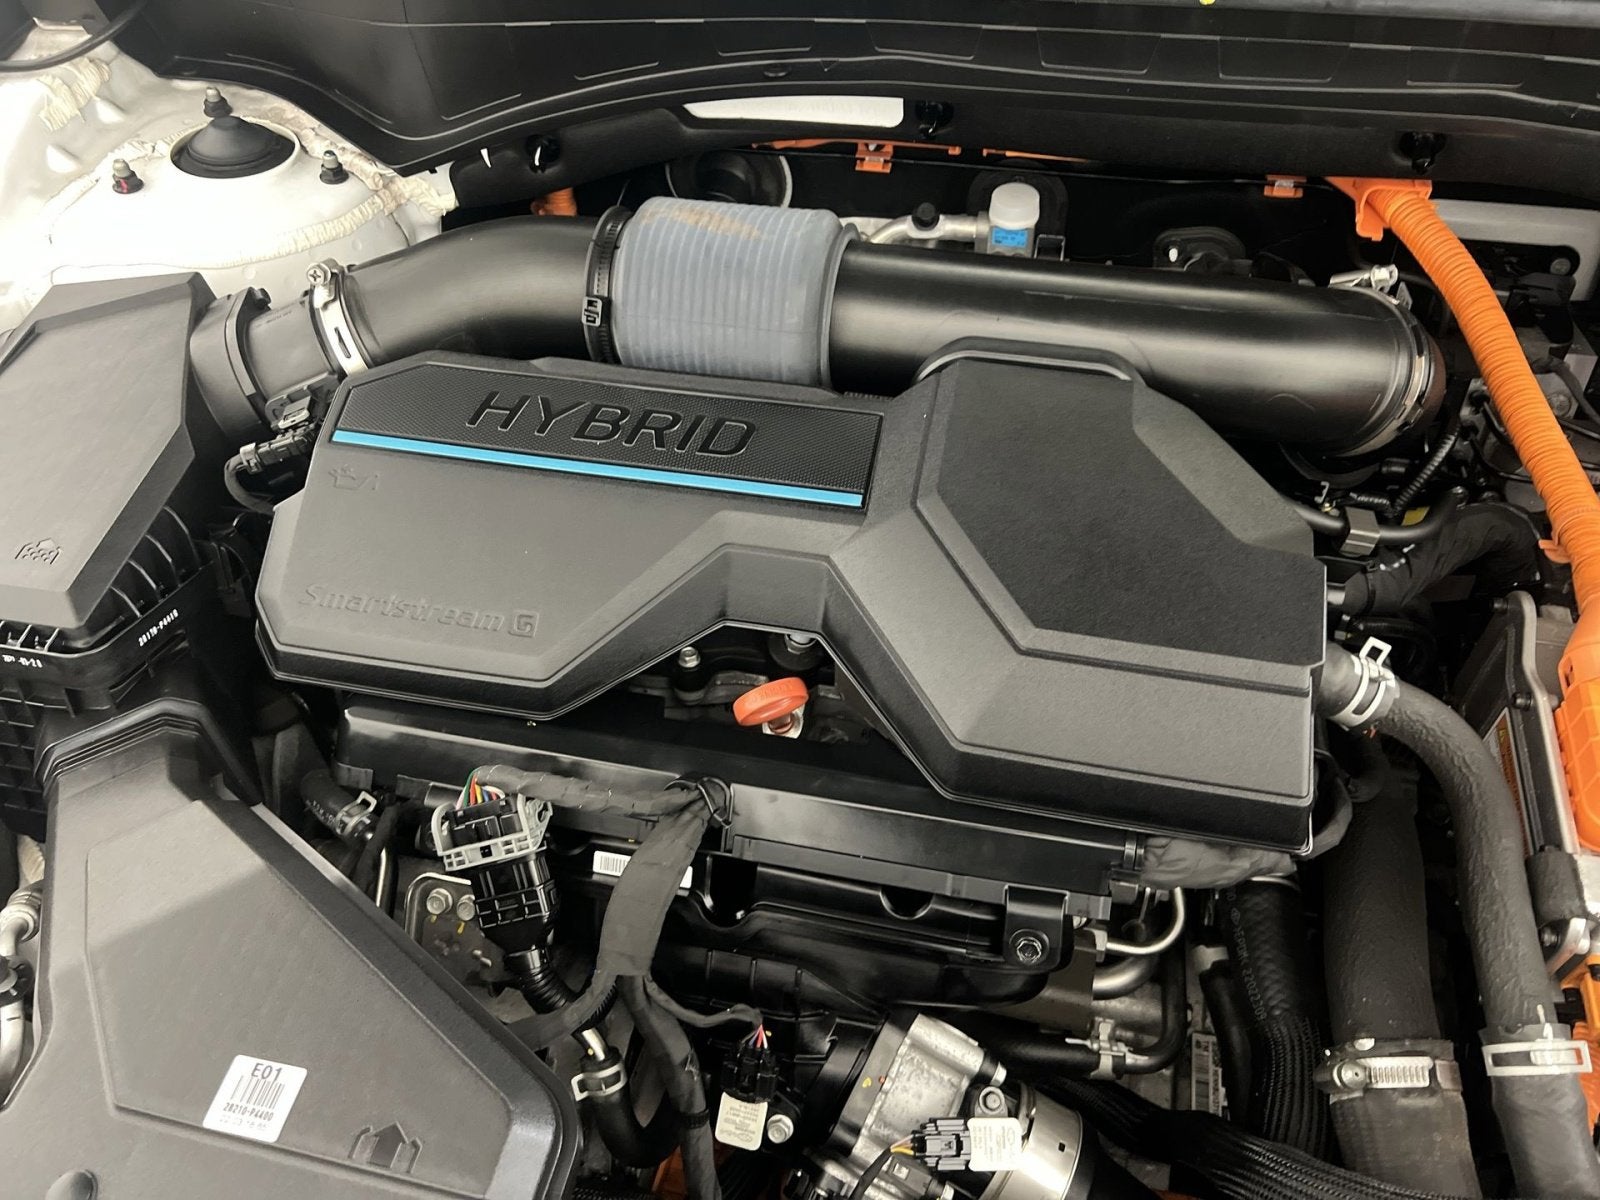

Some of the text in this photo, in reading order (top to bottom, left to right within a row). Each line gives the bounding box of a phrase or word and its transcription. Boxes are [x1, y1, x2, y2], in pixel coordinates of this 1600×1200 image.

[465, 391, 757, 457] HYBRID
[299, 583, 505, 632] Smartstream
[251, 1062, 282, 1081] E01
